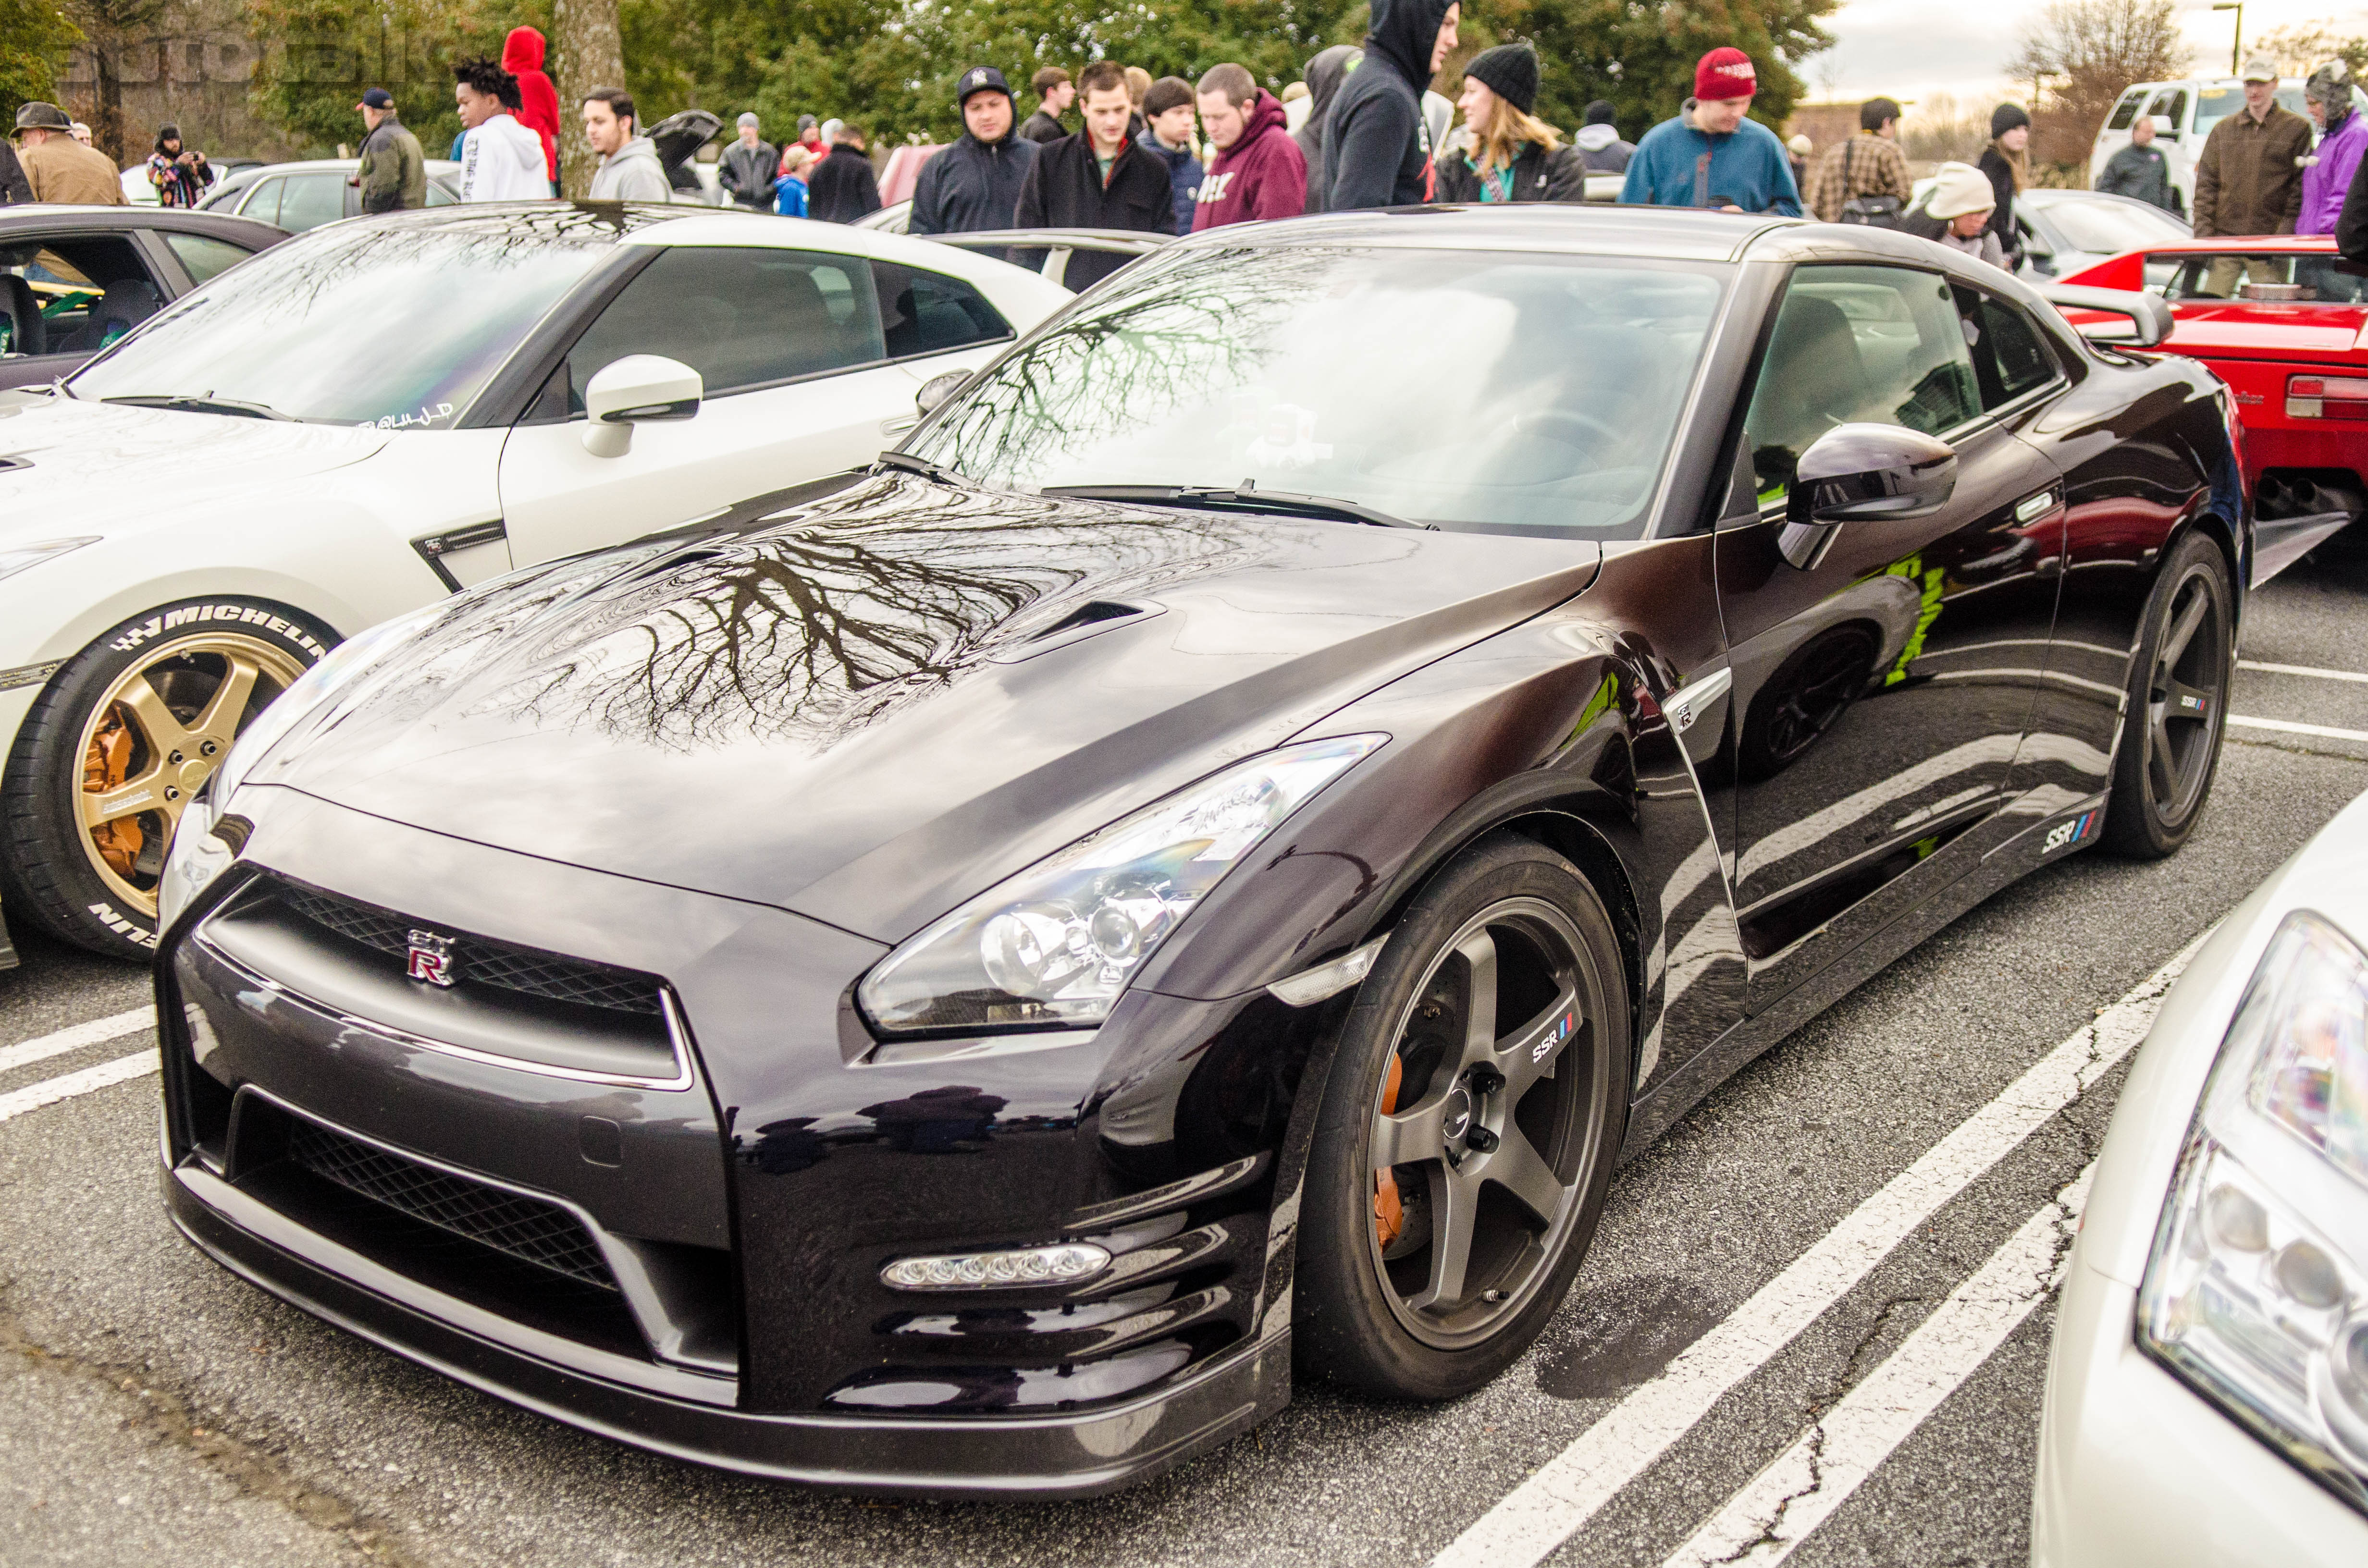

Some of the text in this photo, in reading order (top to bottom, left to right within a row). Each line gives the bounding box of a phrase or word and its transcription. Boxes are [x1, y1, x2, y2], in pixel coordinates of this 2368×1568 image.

[2181, 695, 2197, 708] SSR
[2041, 820, 2076, 854] SSR
[1532, 1029, 1558, 1063] SSR
